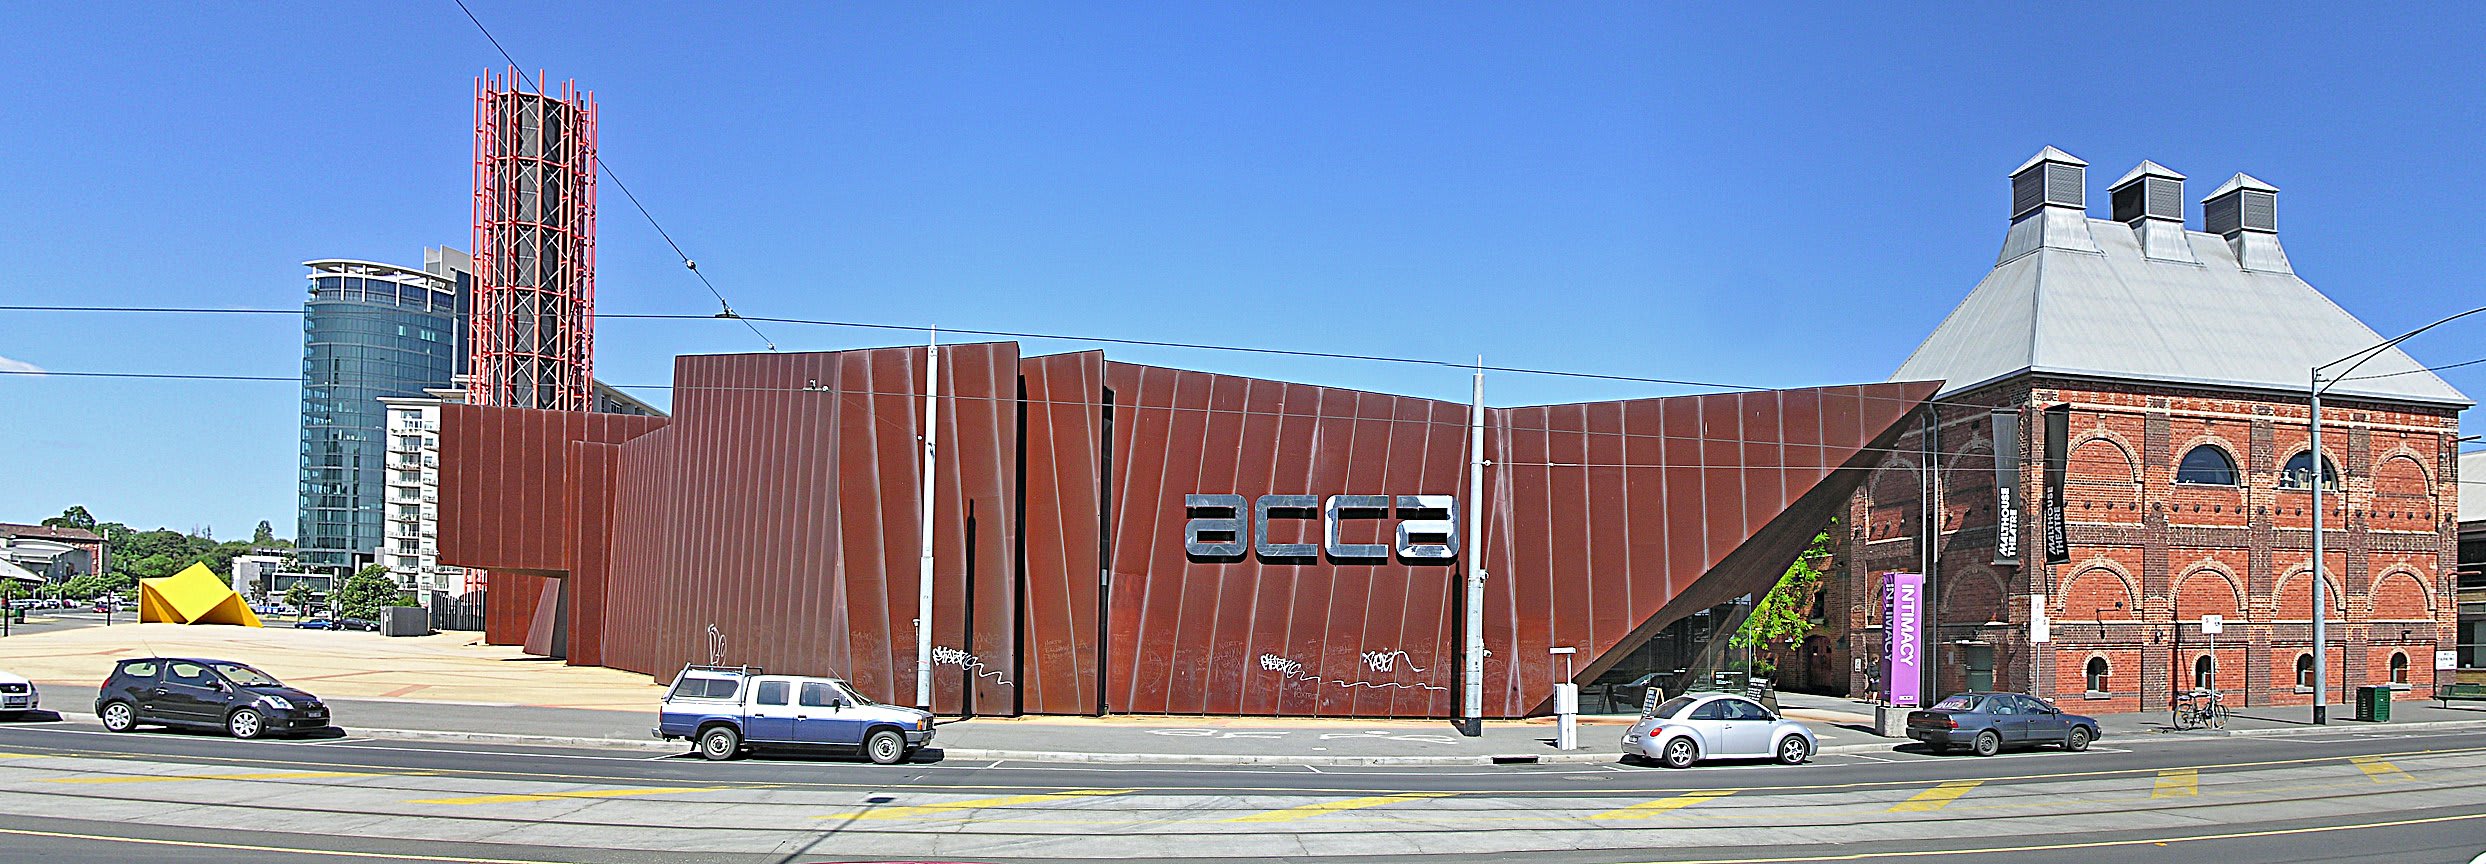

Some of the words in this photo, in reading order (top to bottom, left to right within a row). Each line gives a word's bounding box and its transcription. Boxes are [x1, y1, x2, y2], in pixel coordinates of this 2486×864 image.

[2000, 487, 2010, 557] MALTHOUSE
[2007, 509, 2018, 557] THEATRE
[2047, 486, 2057, 555] MALTHOUSE
[2054, 506, 2065, 555] THEATRE
[1900, 584, 1915, 667] INTIMACY
